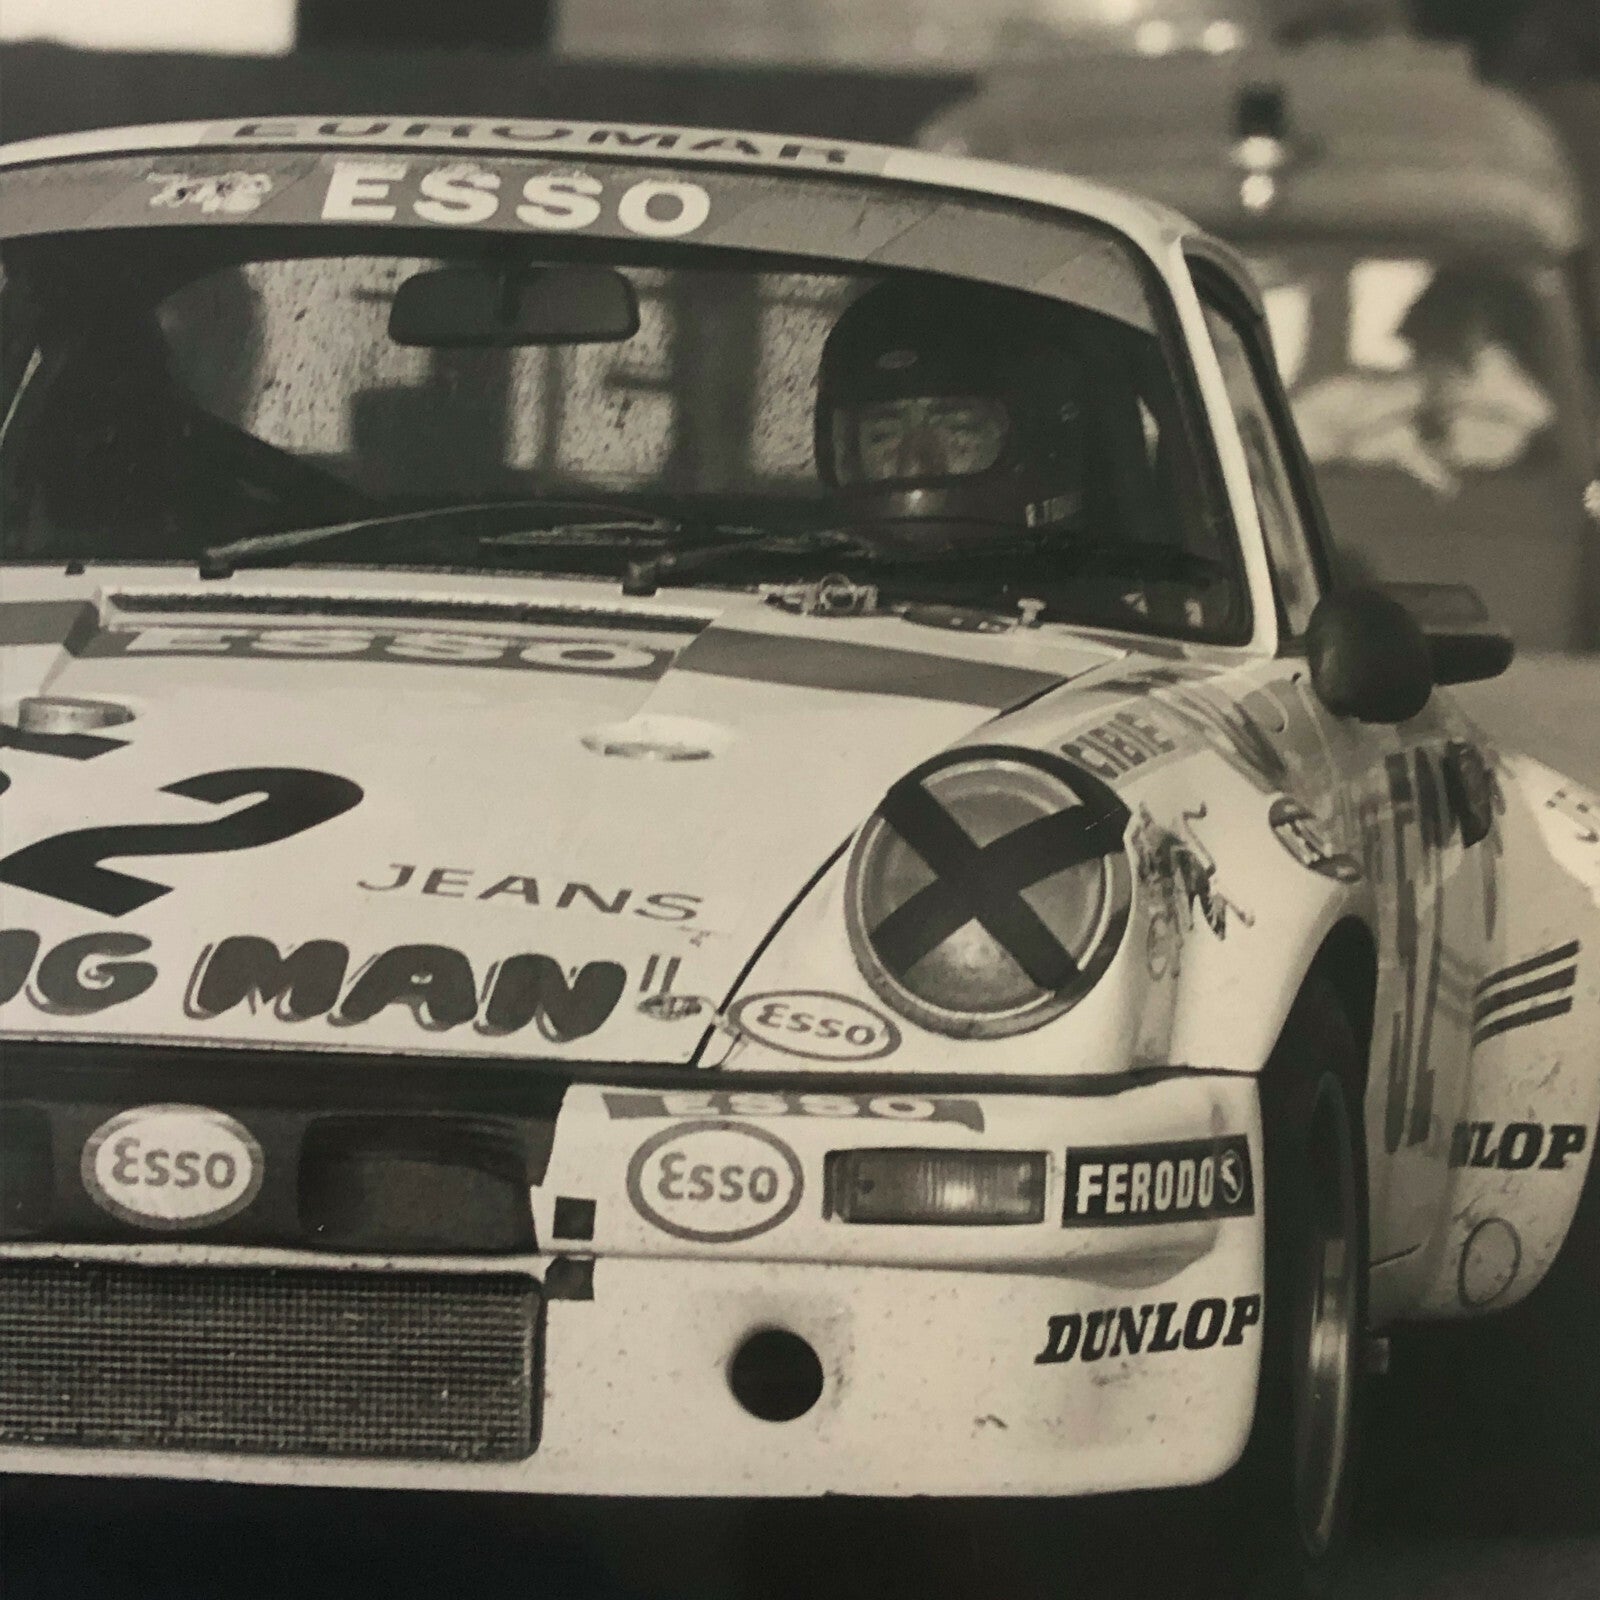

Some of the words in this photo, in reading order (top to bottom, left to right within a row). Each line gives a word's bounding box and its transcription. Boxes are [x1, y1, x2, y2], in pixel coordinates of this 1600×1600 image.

[320, 161, 711, 238] ESSO
[126, 624, 656, 671] ESSO
[357, 864, 704, 922] JEANS
[1076, 1156, 1215, 1214] FERODO
[1035, 1293, 1262, 1365] DUNLOP
